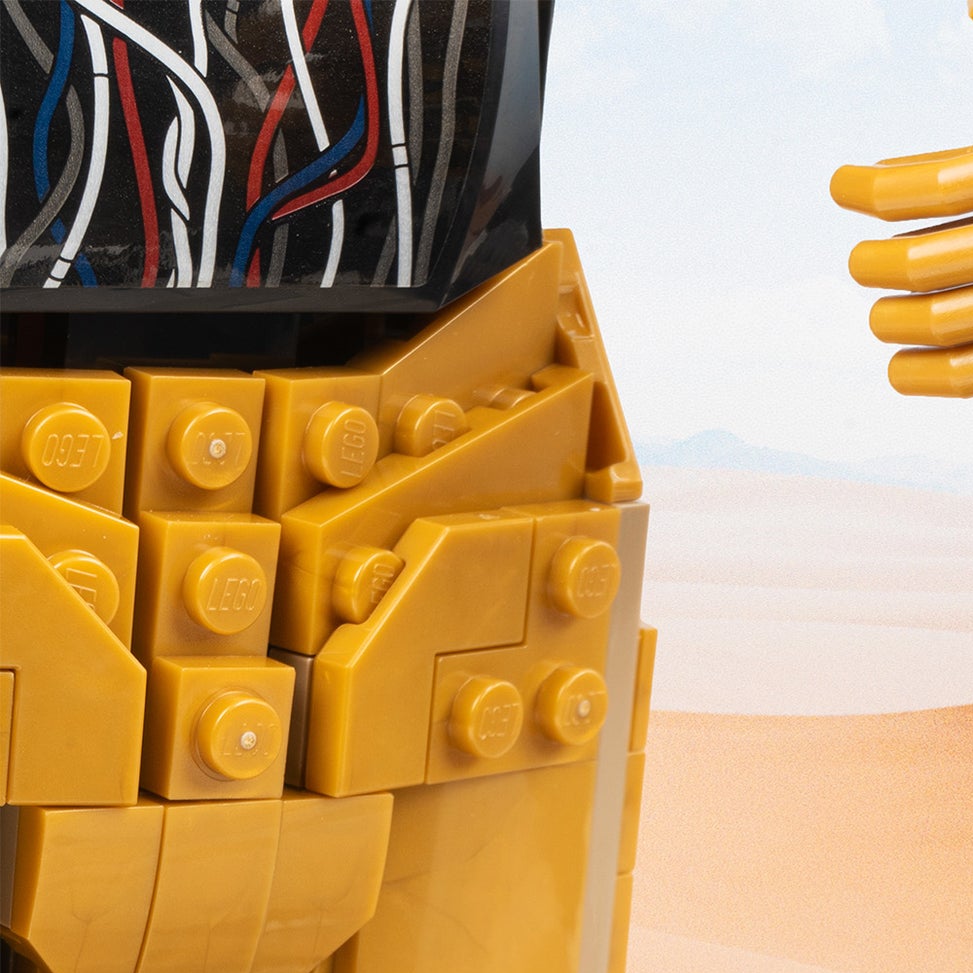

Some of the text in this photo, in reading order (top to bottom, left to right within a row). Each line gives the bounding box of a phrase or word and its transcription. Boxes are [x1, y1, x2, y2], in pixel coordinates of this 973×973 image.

[41, 433, 105, 467] LEGO
[340, 418, 367, 479] LEGO
[206, 577, 263, 611] LEGO
